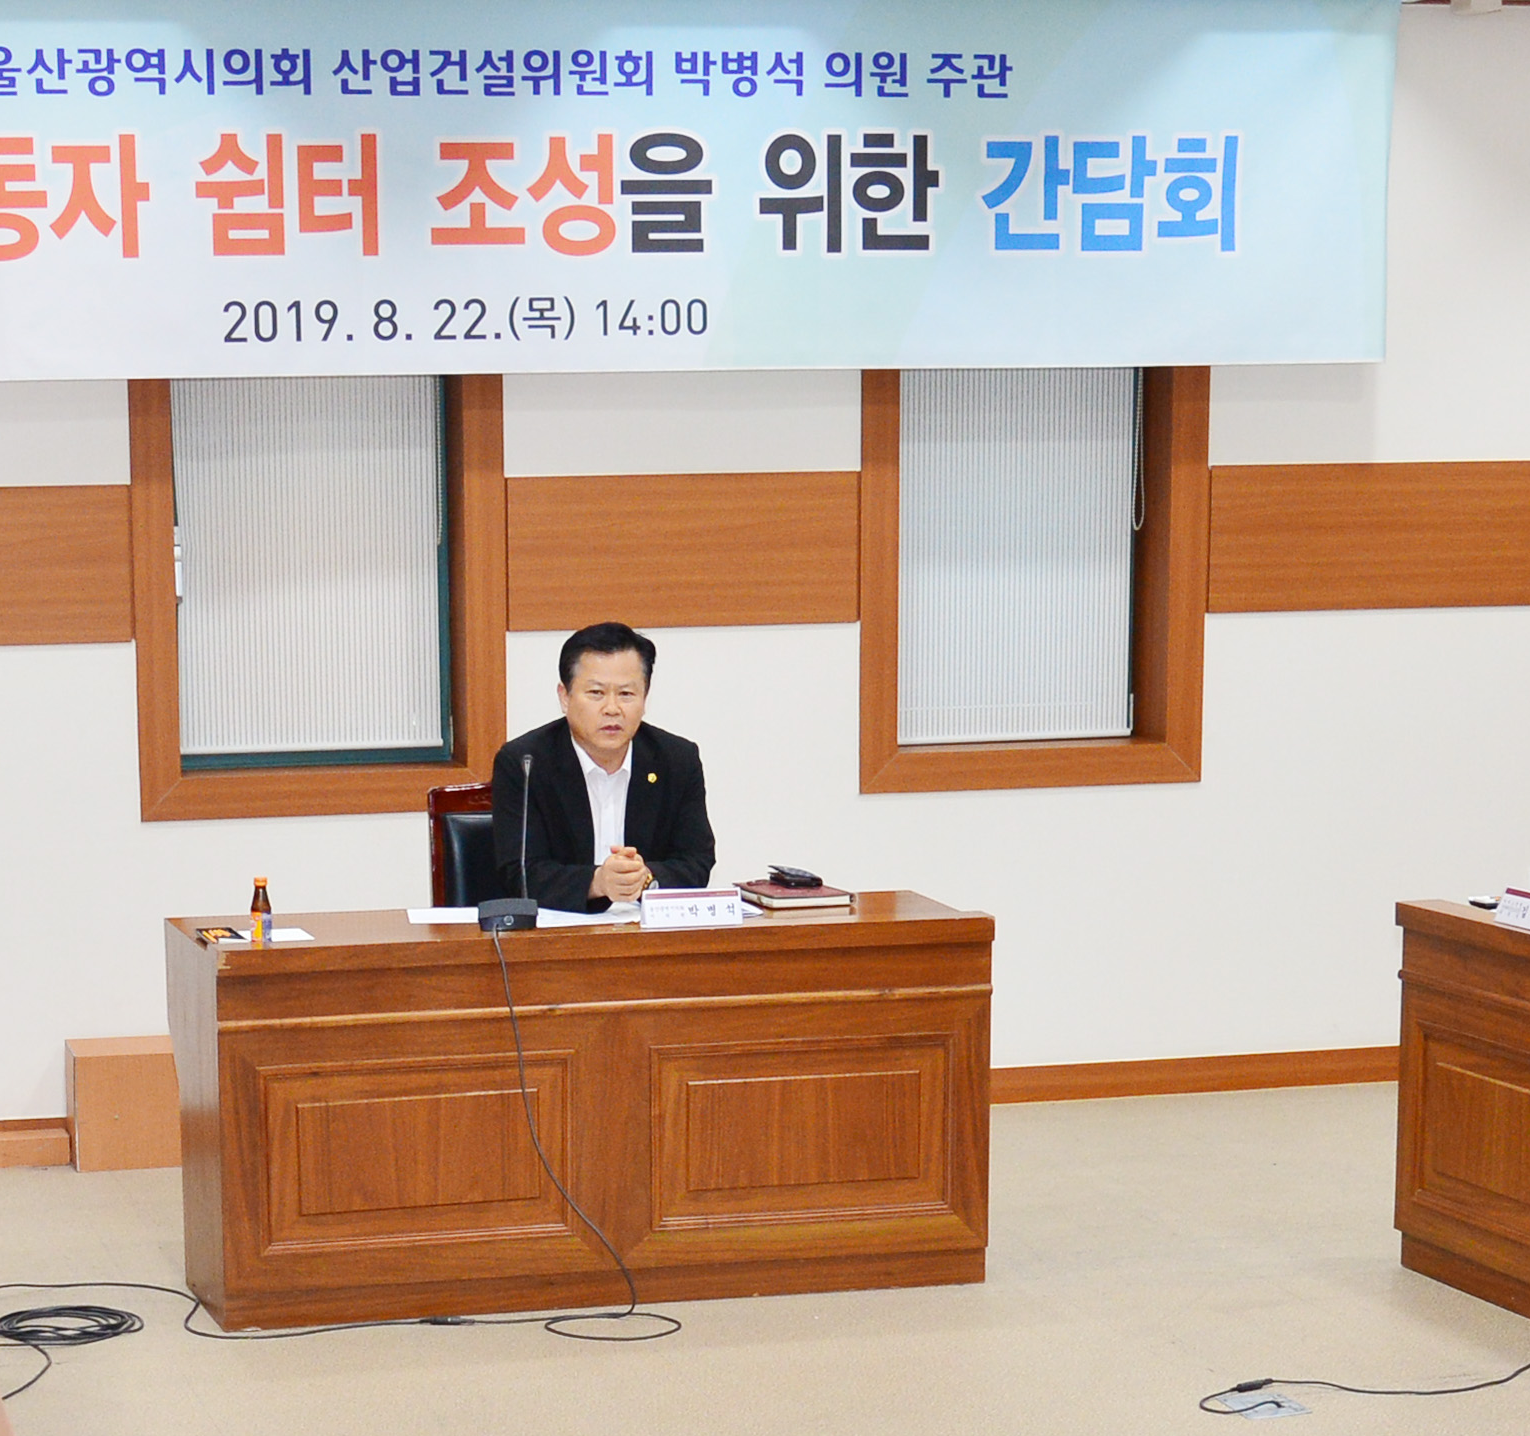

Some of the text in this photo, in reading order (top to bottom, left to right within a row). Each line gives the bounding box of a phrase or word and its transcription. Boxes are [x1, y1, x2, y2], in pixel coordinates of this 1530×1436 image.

[331, 48, 654, 97] 산업건설위원회
[674, 50, 804, 98] 박병석
[824, 50, 910, 98] 의원
[925, 52, 1014, 99] 주관
[195, 133, 379, 256] 쉼터
[431, 133, 712, 256] 조성을
[759, 133, 940, 253] 위한
[981, 135, 1239, 252] 간담회
[223, 299, 354, 343] 2019.
[373, 299, 413, 341] 8.
[595, 298, 708, 336] 14:00
